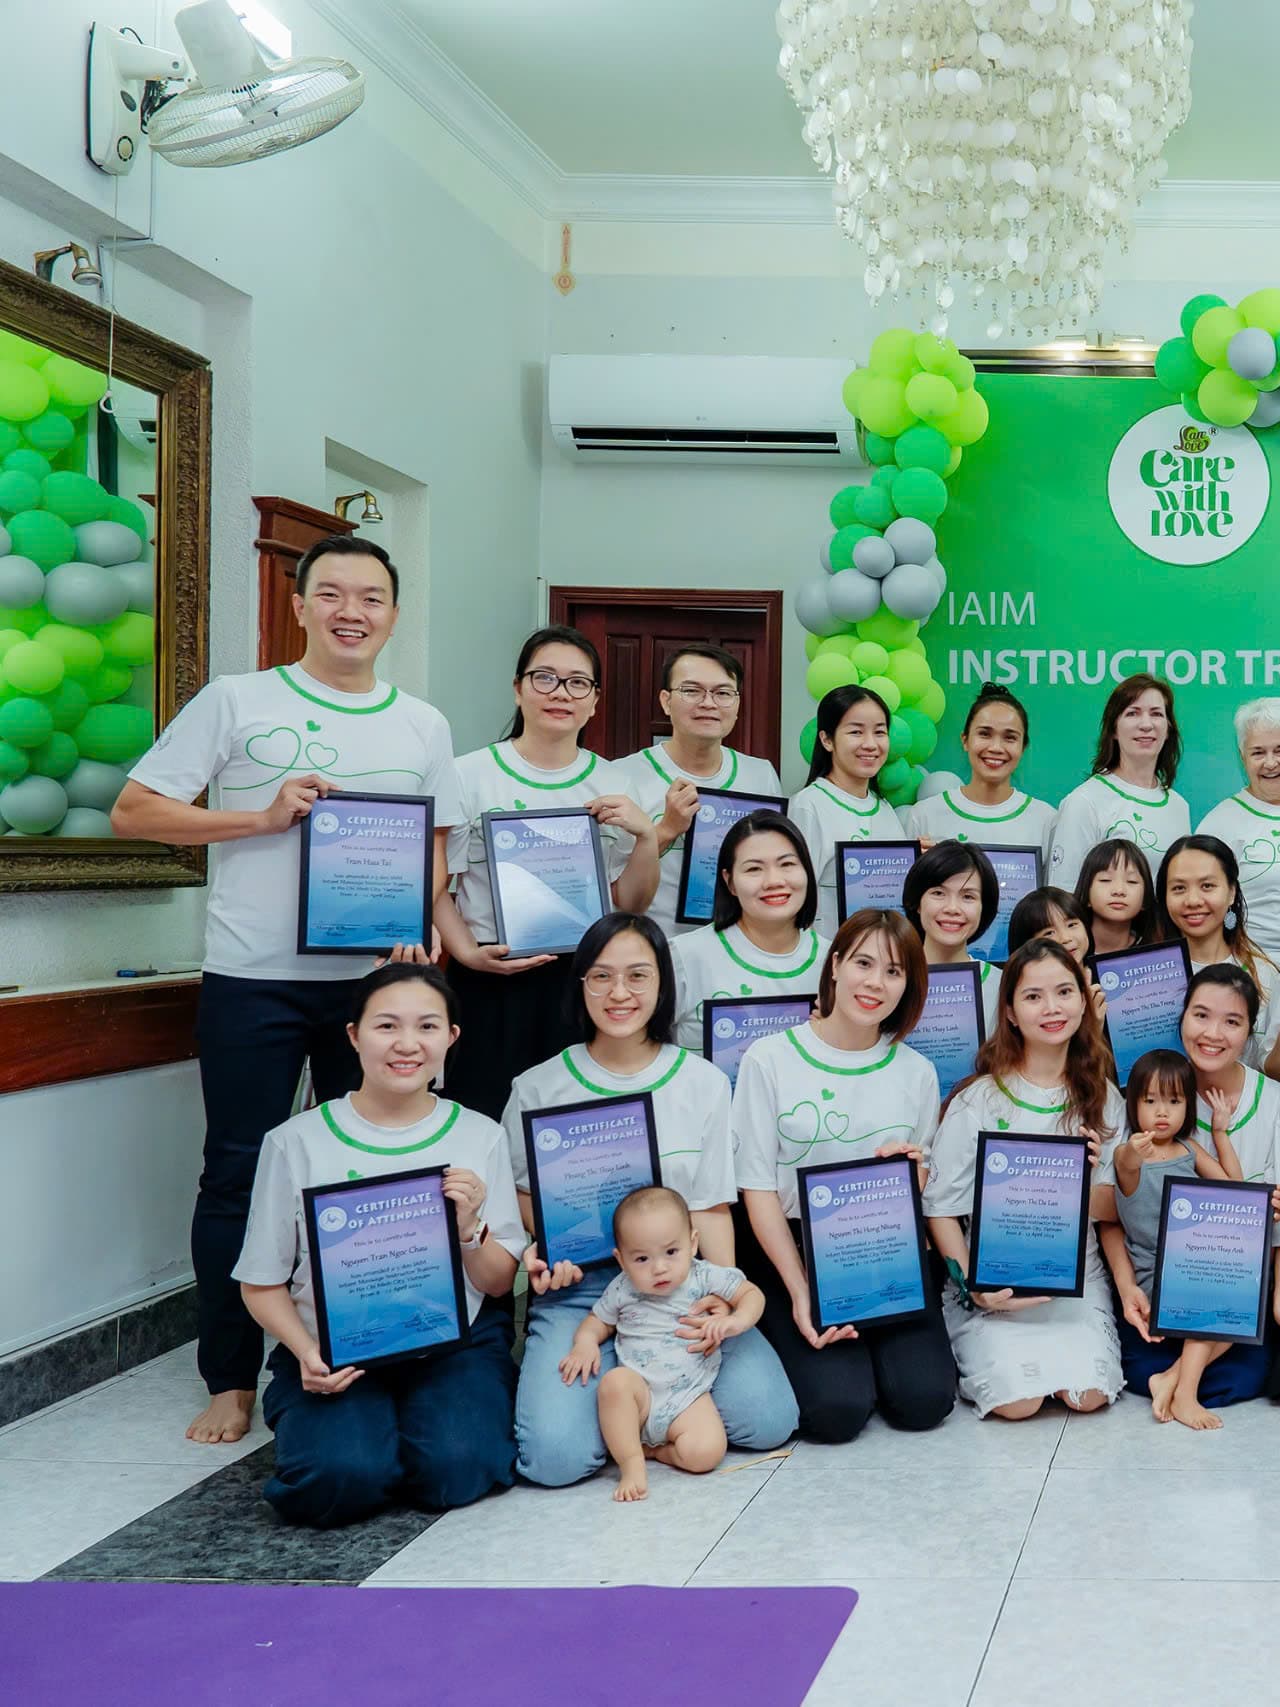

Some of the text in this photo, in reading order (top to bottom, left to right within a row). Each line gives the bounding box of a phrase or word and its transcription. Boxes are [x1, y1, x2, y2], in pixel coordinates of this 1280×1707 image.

[1140, 449, 1235, 487] Care
[1155, 481, 1229, 511] with
[949, 591, 1036, 625] IAIM
[949, 649, 1227, 685] INSTRUCTOR
[722, 809, 752, 817] CERTIF
[347, 816, 416, 827] CERTIFICATE
[339, 827, 423, 840] OF ATTENDANCE
[864, 858, 908, 866] CERTIFICATE
[1124, 960, 1176, 977] CERTIFICATE
[1134, 970, 1184, 986] ATTENDANCE
[742, 1016, 800, 1026] CERTIFICATE
[735, 1030, 747, 1039] OF
[568, 1116, 636, 1135] CERTIFICATE
[562, 1128, 644, 1149] OF ATTENDANCE
[1015, 1156, 1074, 1167] CERTIFICATE
[1007, 1167, 1080, 1179] OF ATTENDANCE
[838, 1176, 901, 1193] CERTIFICATE
[355, 1192, 432, 1214] CERTIFICATE
[833, 1188, 909, 1206] OF ATTENDANCE
[1199, 1202, 1257, 1215] CERTIFICATE
[349, 1205, 441, 1229] OF ATTENDANCE
[1192, 1214, 1263, 1227] OF ATTENDANCE
